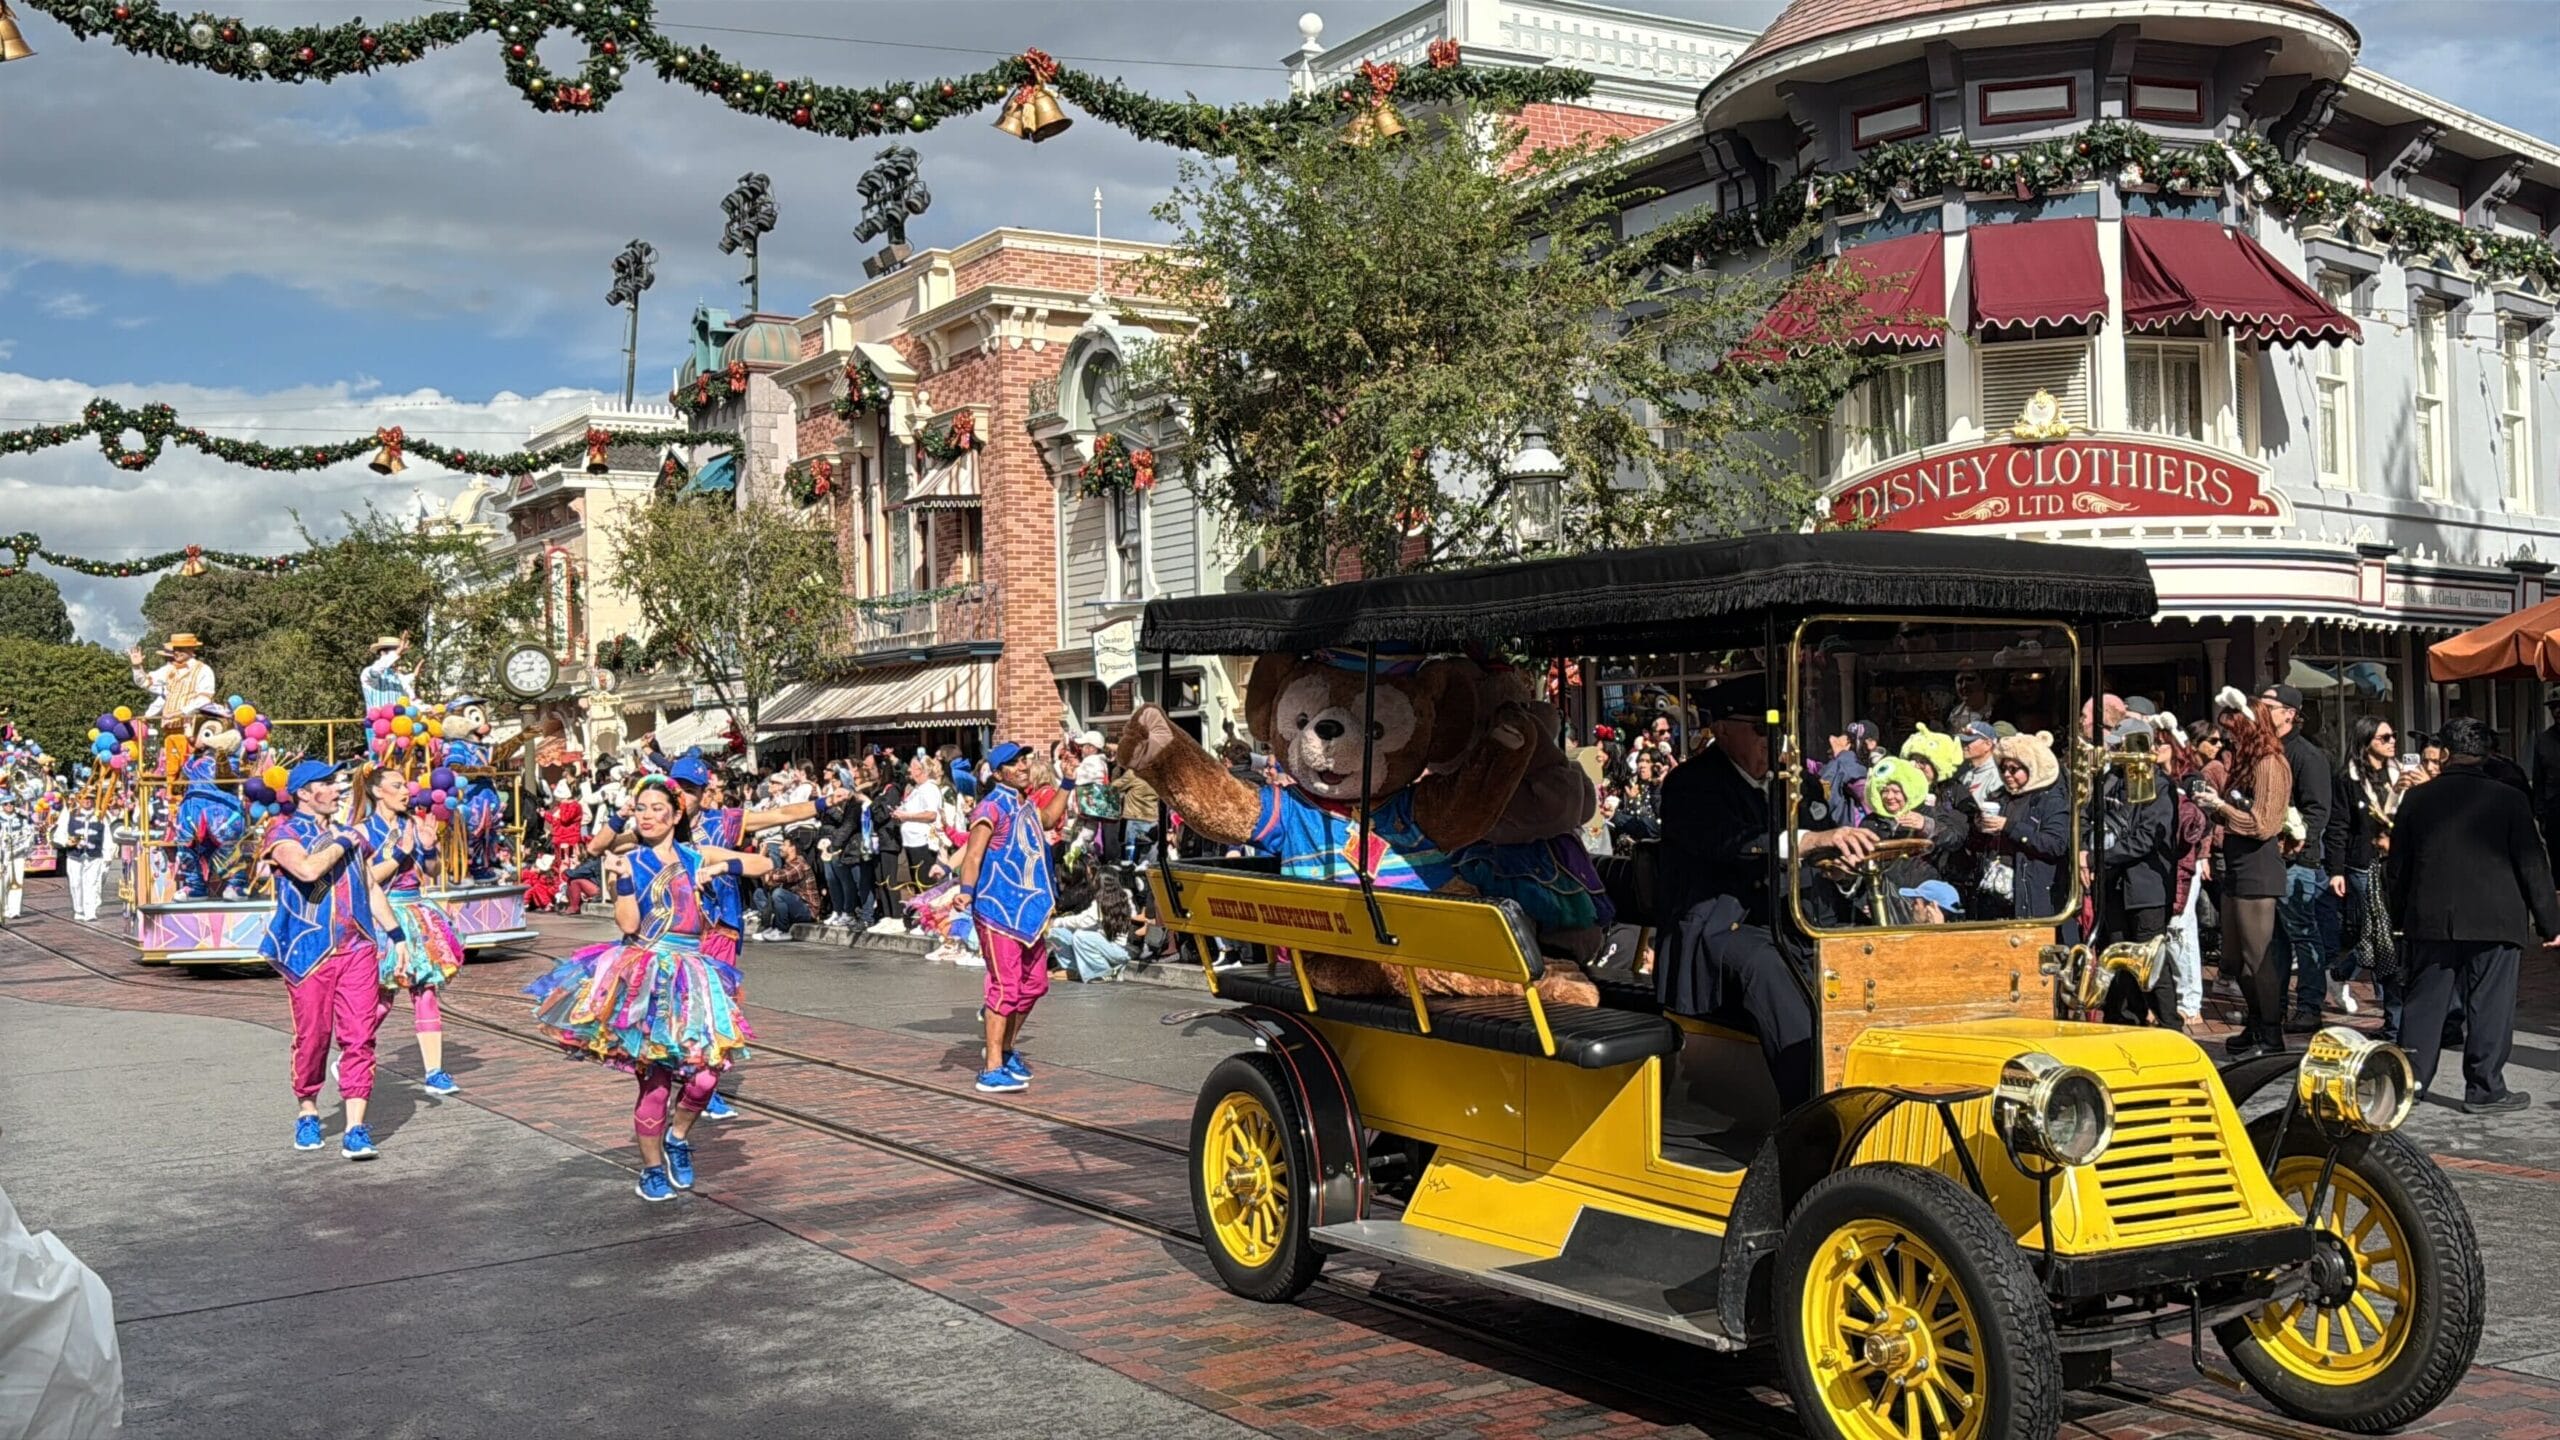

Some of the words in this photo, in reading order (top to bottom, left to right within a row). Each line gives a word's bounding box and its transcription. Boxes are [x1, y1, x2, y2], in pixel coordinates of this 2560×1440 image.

[1856, 453, 1998, 519] DISNEY
[2007, 447, 2233, 506] CLOTHIERS
[2018, 495, 2065, 516] LTD.
[1207, 897, 1258, 922] DISNEYLAND
[1258, 904, 1334, 932] TRANSPORTATION
[1333, 912, 1353, 935] CO.
